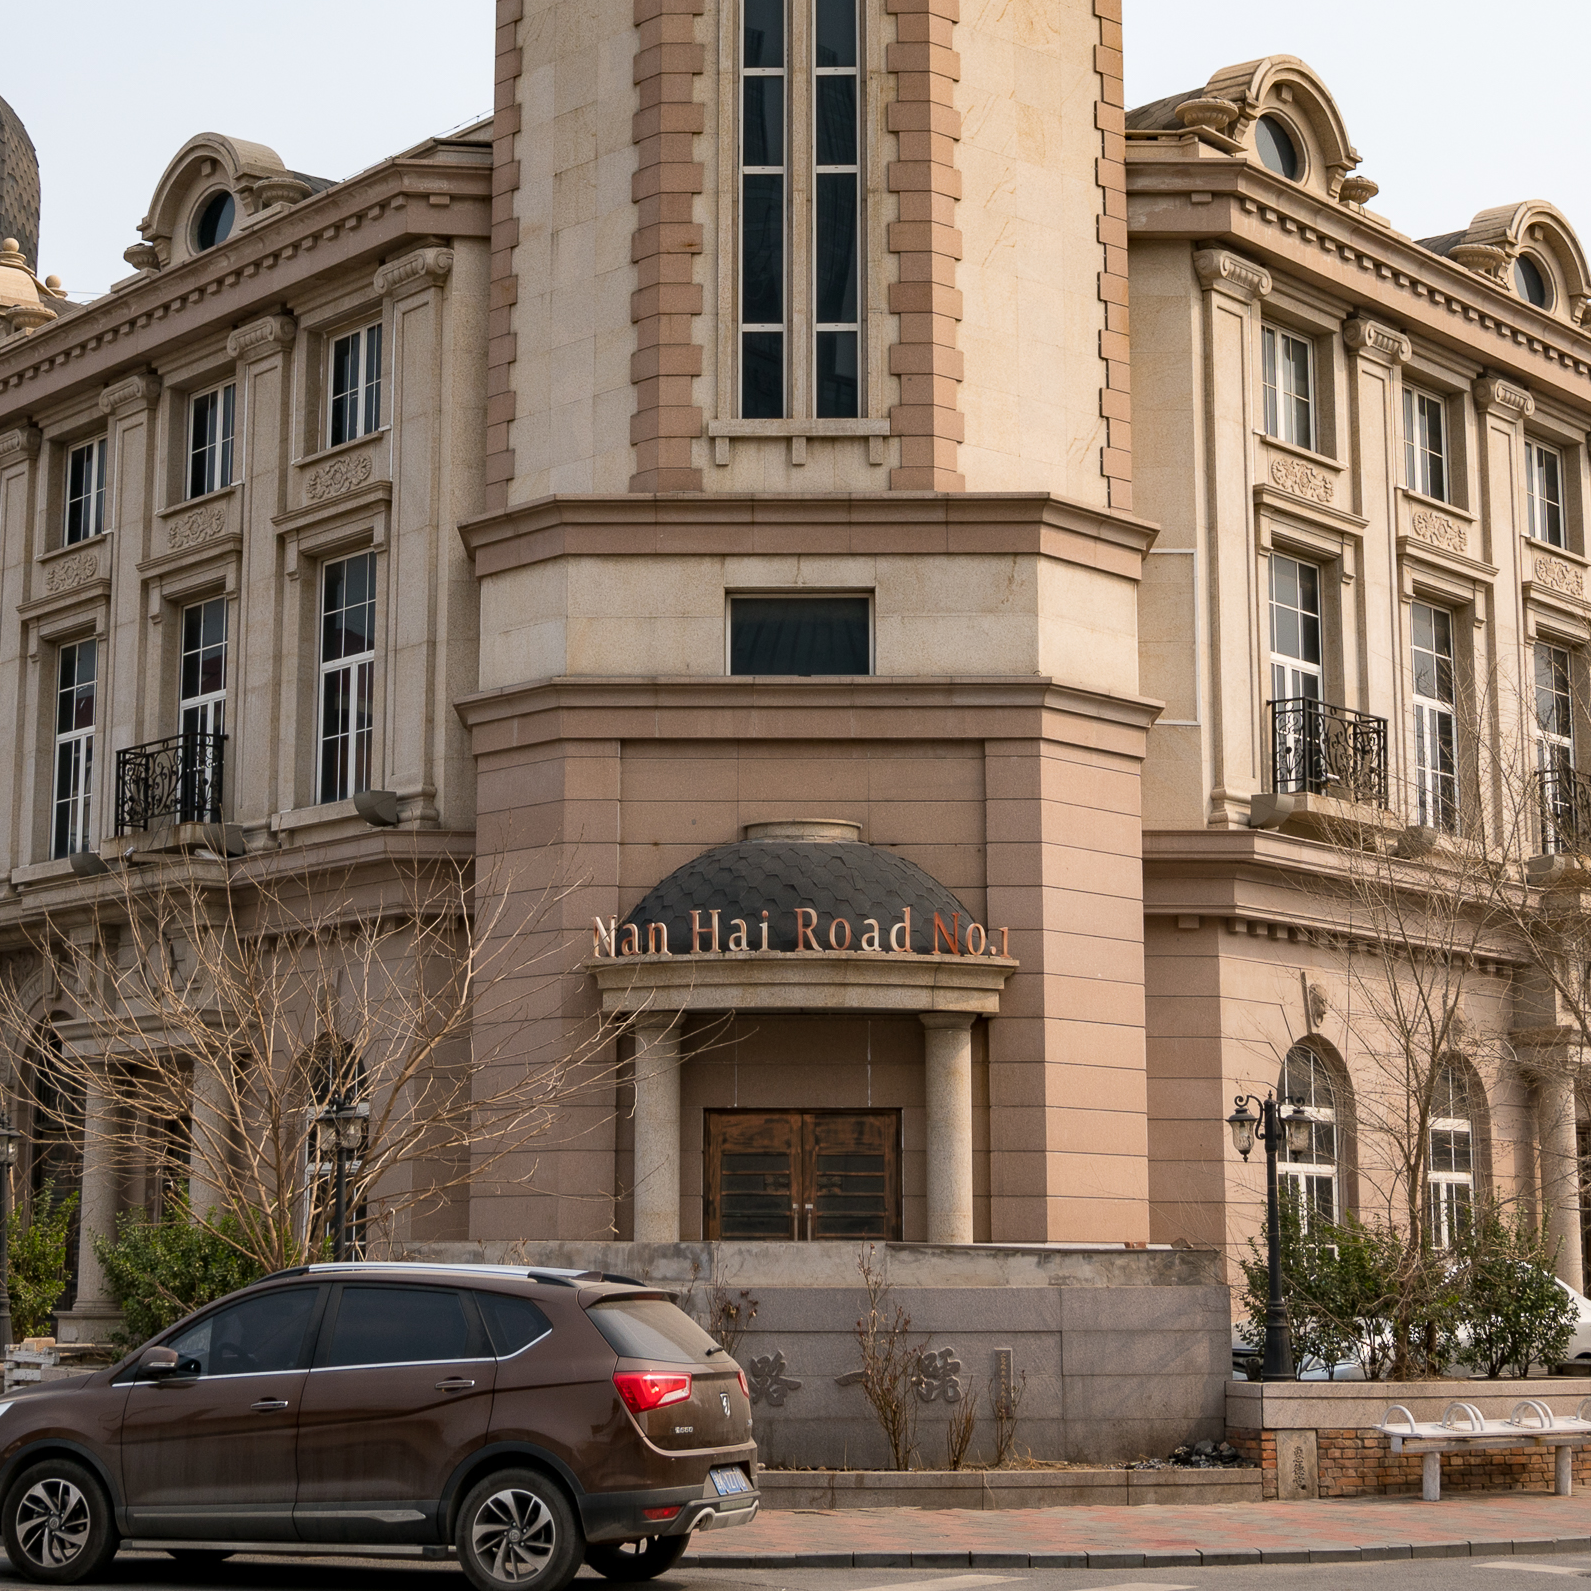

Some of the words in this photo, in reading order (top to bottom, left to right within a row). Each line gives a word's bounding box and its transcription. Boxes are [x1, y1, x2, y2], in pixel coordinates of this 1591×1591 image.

[592, 914, 672, 959] Nan
[689, 909, 771, 953] Hai
[794, 907, 913, 953] Road
[931, 911, 1011, 959] No.1
